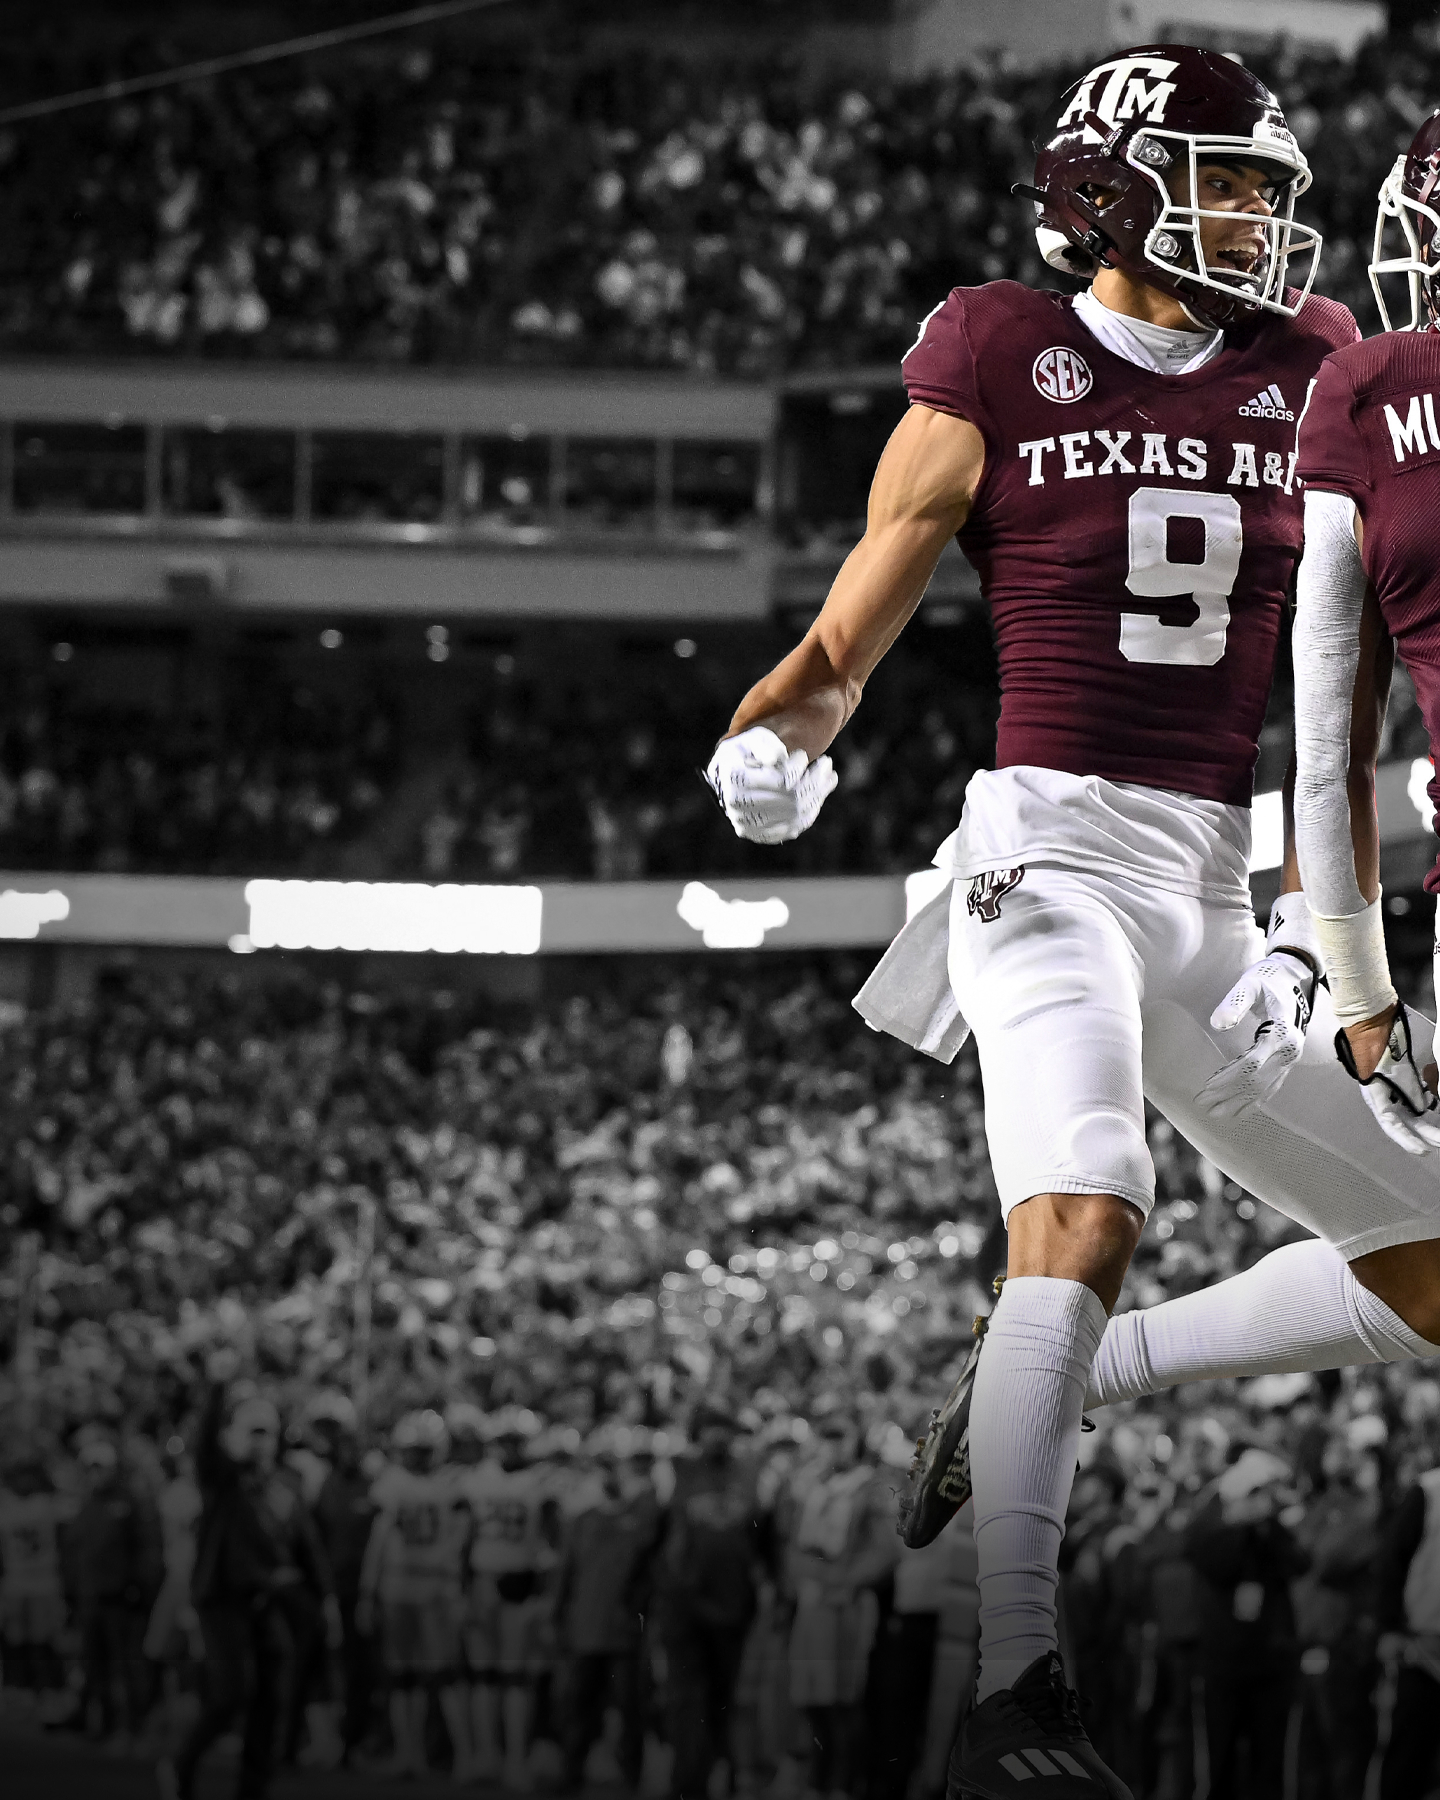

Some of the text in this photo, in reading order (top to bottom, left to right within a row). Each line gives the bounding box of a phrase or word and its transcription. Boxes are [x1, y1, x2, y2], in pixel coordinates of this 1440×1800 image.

[1038, 350, 1088, 399] SEC
[1238, 404, 1295, 422] adidas
[1018, 429, 1208, 487] TEXAS
[1118, 486, 1243, 666] 9
